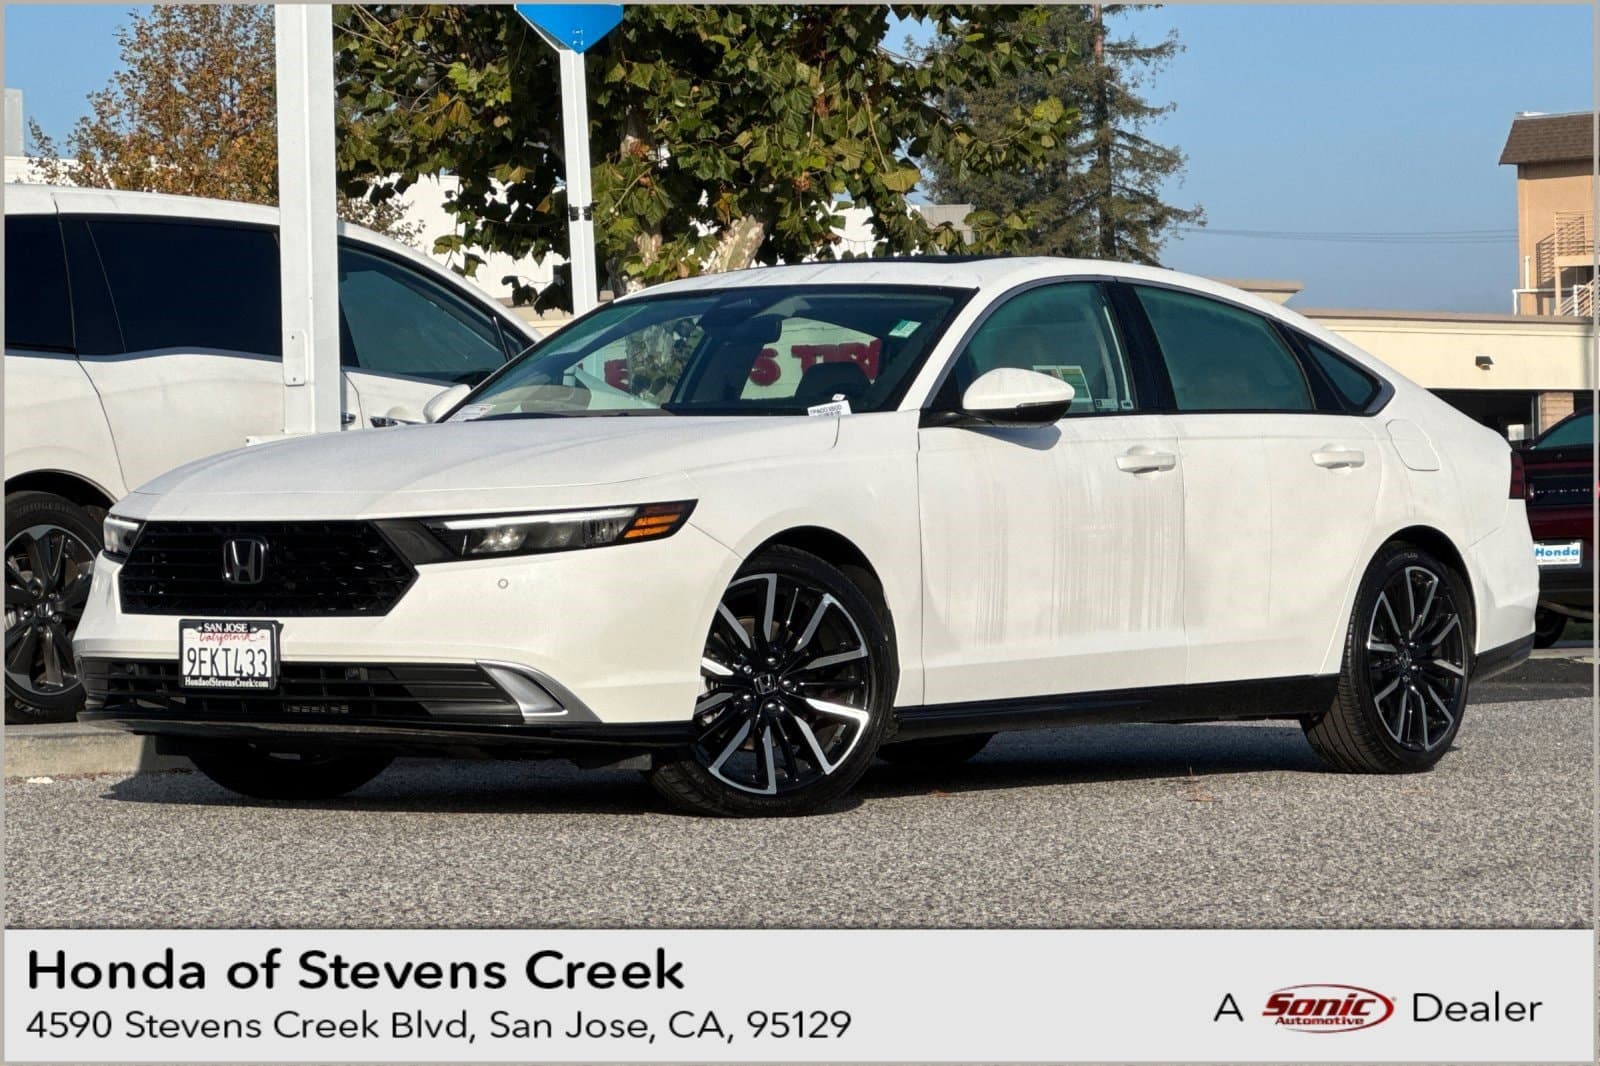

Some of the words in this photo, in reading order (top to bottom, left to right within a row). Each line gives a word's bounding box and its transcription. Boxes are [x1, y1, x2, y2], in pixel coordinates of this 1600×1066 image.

[1535, 547, 1579, 557] Honda
[204, 622, 222, 633] SAN
[224, 622, 248, 633] JOSE
